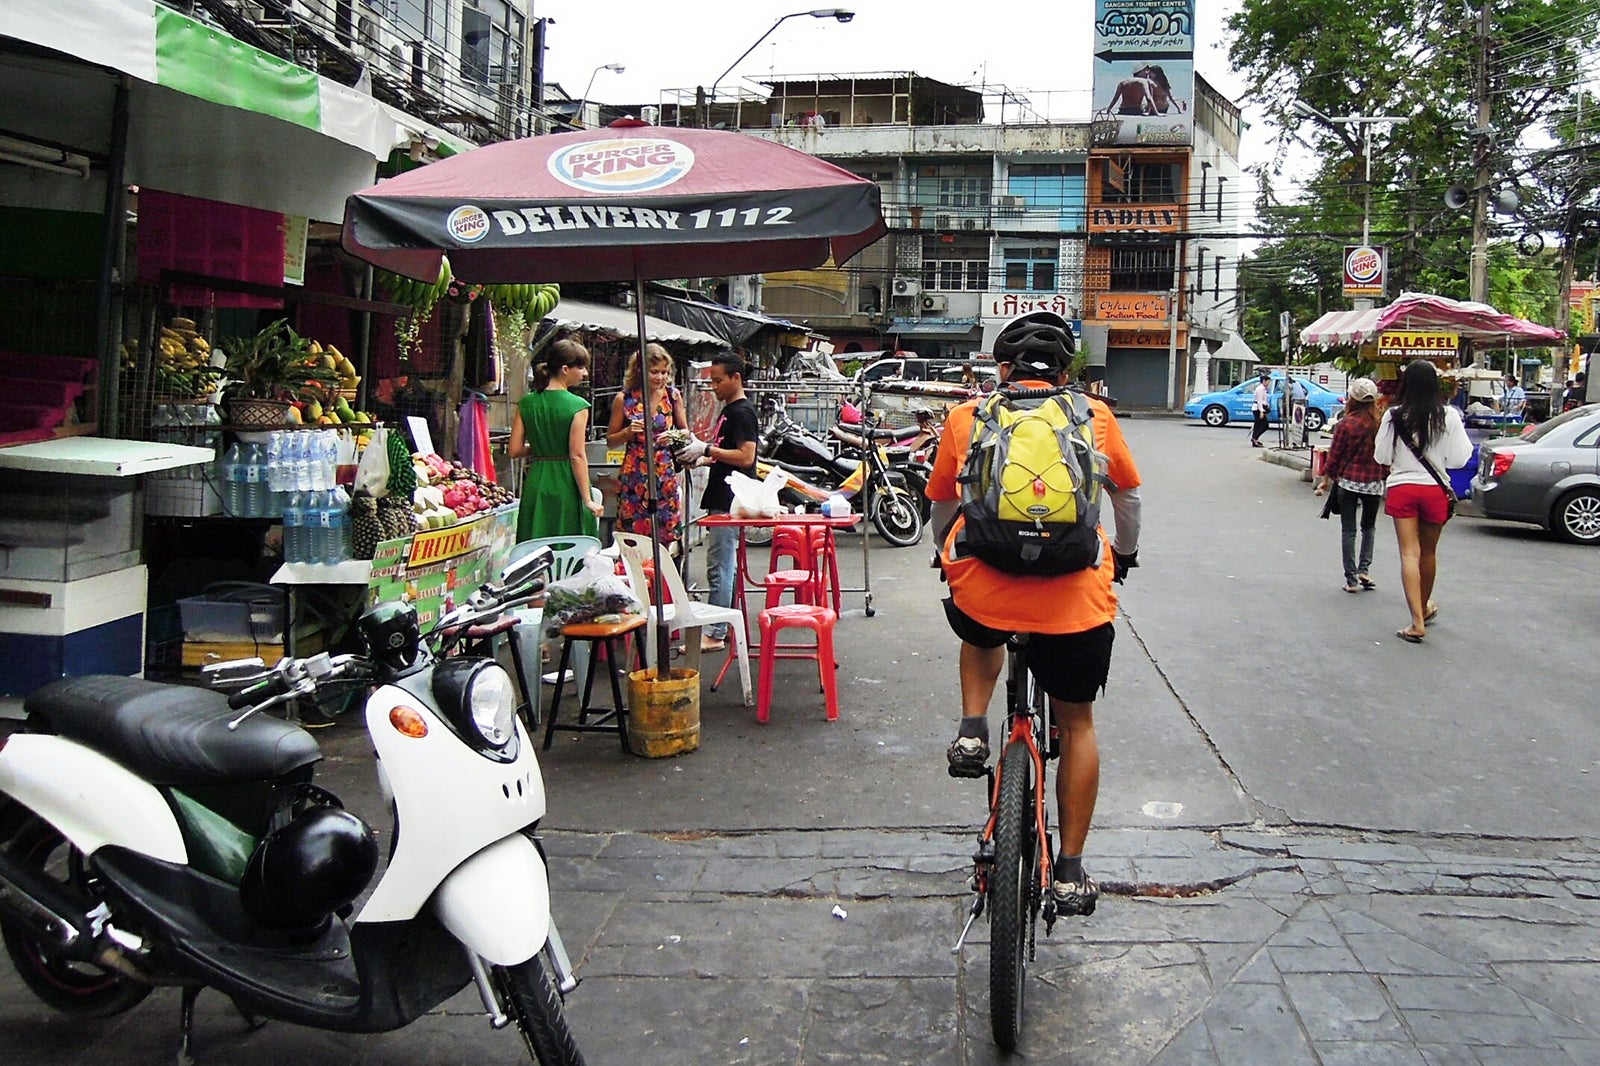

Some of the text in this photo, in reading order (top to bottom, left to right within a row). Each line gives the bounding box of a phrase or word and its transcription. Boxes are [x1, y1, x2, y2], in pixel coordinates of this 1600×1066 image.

[1094, 131, 1117, 142] 24/7
[569, 144, 671, 165] BURGER
[572, 152, 676, 179] KING
[453, 213, 483, 227] BURGER
[492, 205, 796, 237] DELIVERY 1112
[1092, 208, 1175, 226] INDIAN
[455, 219, 485, 234] KING
[1352, 254, 1377, 266] BURGER
[1352, 260, 1377, 274] KING
[1105, 311, 1159, 320] Indian Food
[1381, 336, 1455, 348] FALAFEL
